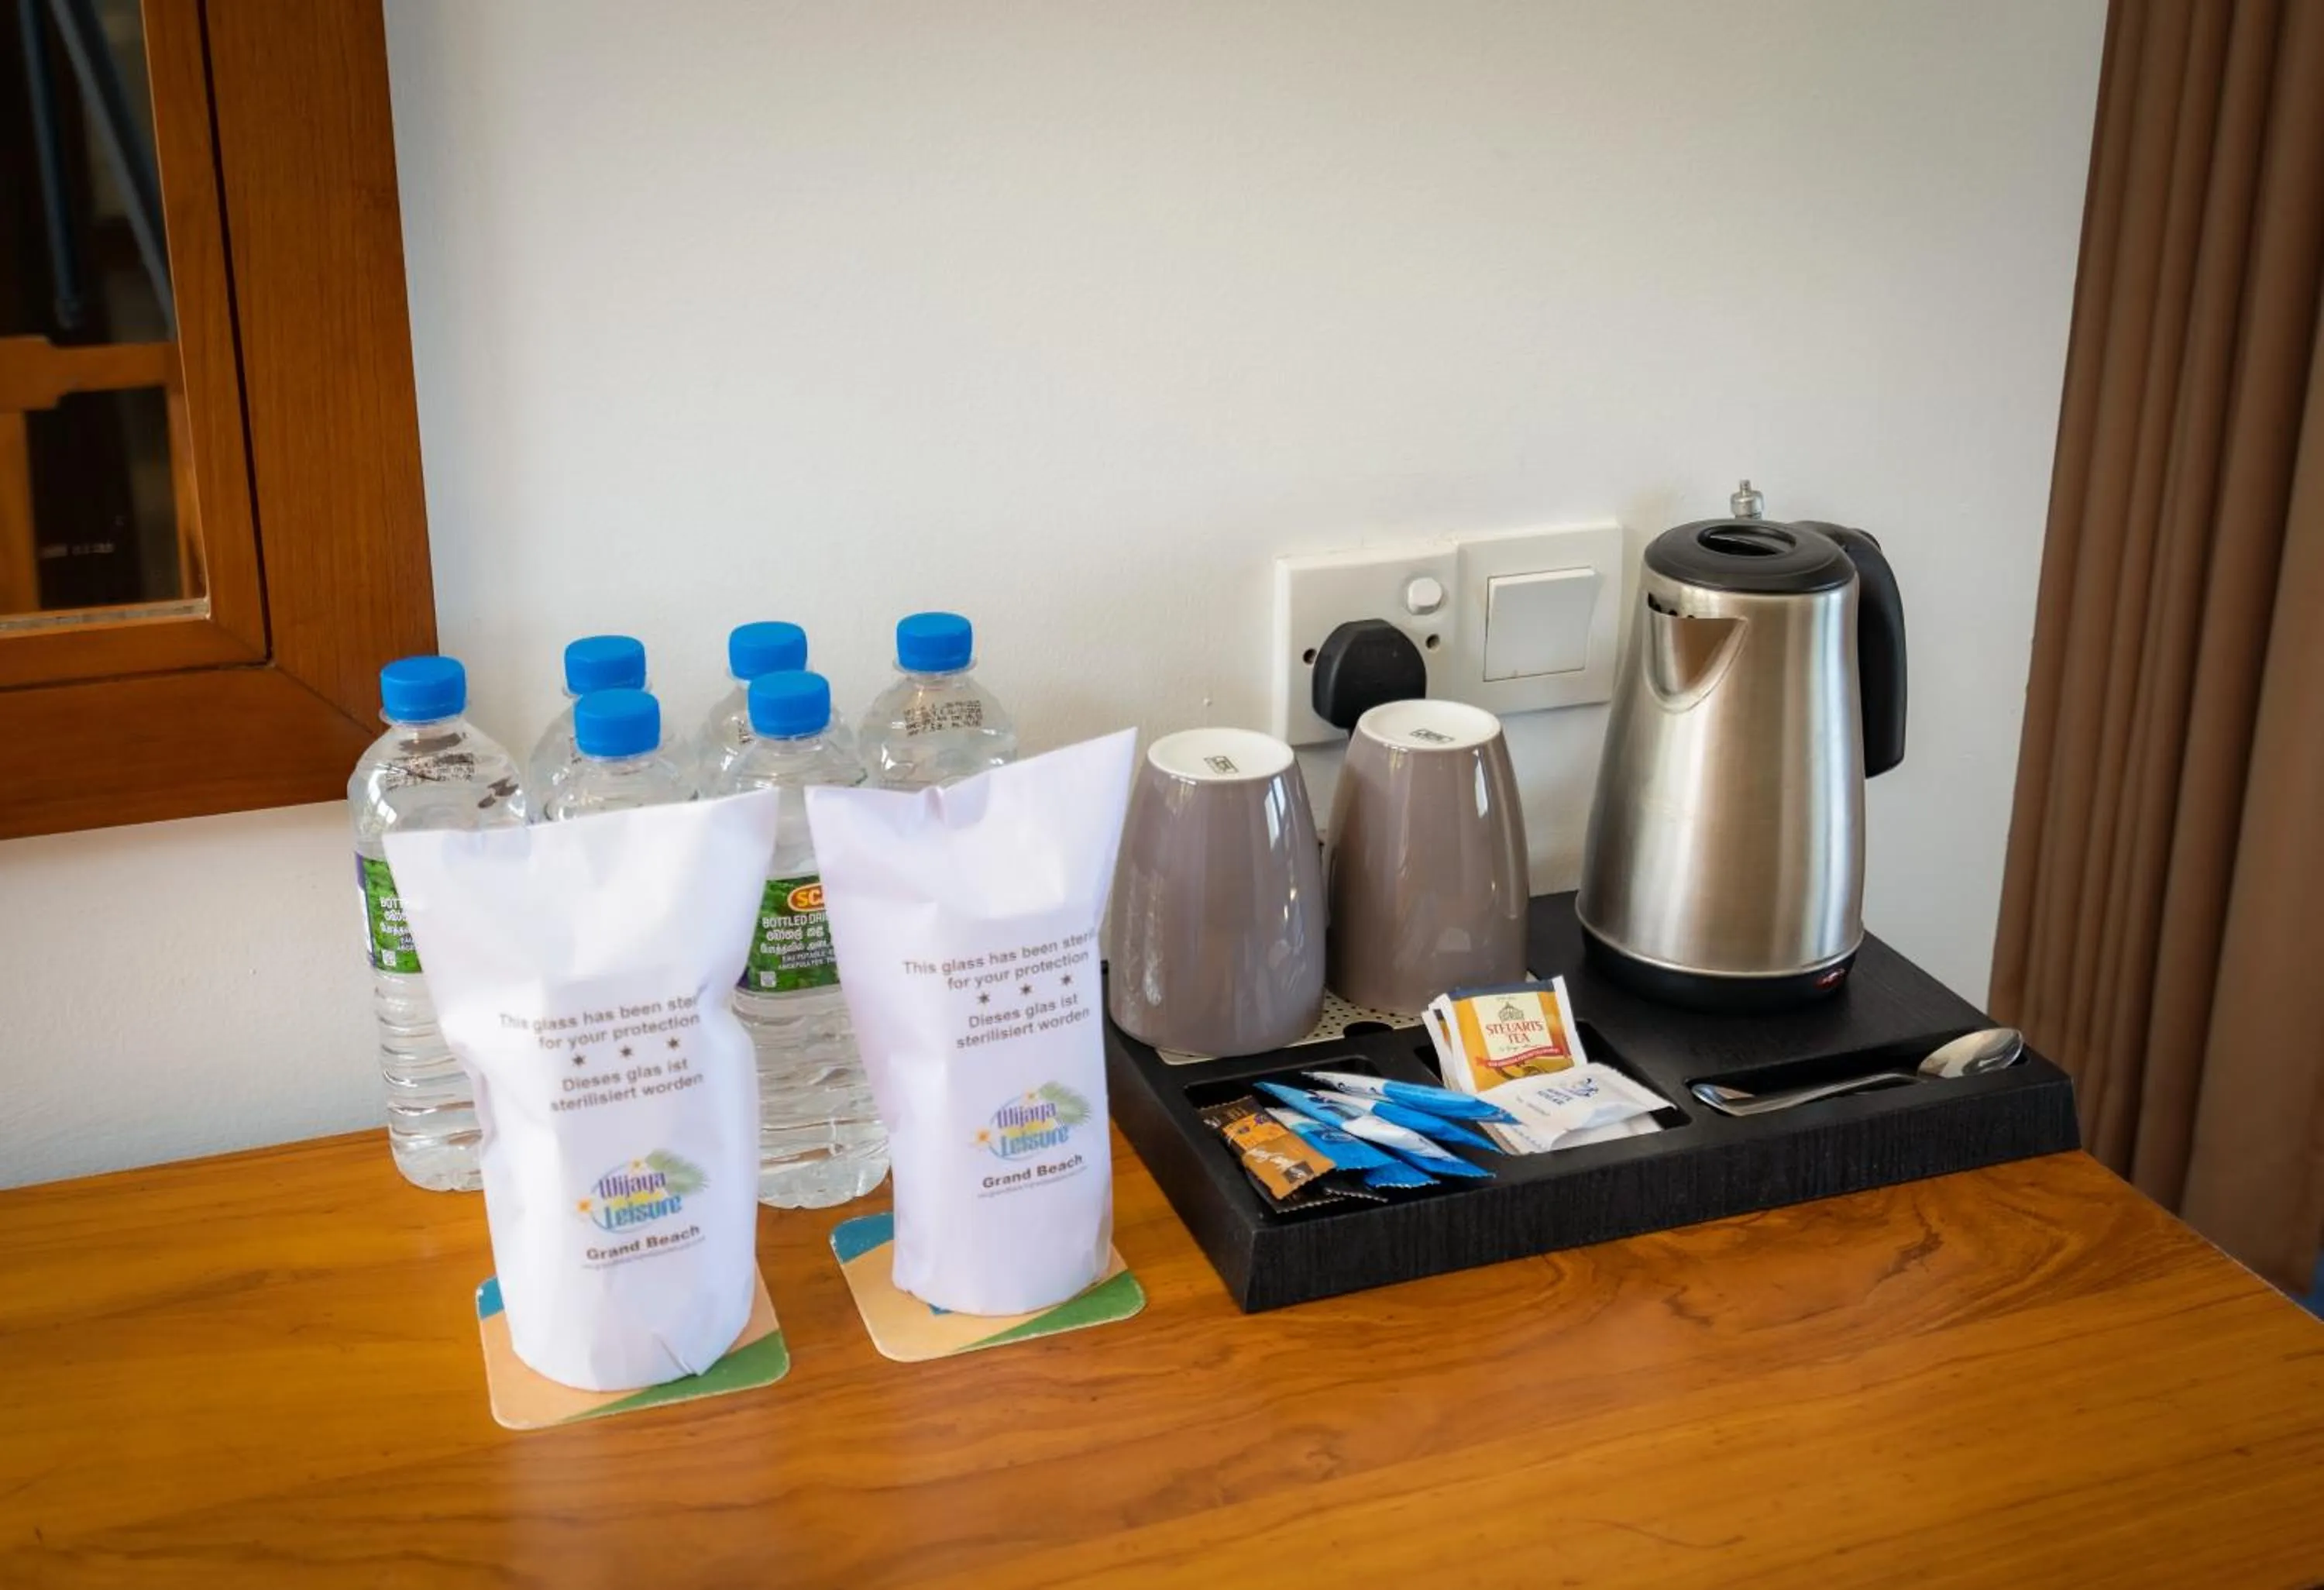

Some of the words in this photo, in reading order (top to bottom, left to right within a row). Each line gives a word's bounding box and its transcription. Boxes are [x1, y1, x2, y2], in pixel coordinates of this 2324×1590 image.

[796, 889, 824, 907] SC
[762, 914, 807, 928] BOTTLED
[902, 961, 937, 975] This
[941, 957, 984, 976] glass
[989, 952, 1016, 965] has
[1022, 941, 1057, 959] been
[947, 976, 969, 991] for
[975, 972, 1009, 989] your
[1015, 951, 1089, 981] protection
[499, 1014, 528, 1031] This
[533, 1015, 577, 1034] glass
[583, 1011, 614, 1025] has
[620, 1001, 662, 1020] been
[956, 1024, 1033, 1049] sterilisiert
[1038, 1007, 1091, 1031] worden
[968, 1008, 1020, 1029] Dieses
[1025, 1000, 1057, 1019] glas
[1061, 993, 1078, 1007] ist
[1485, 1020, 1544, 1035] STEUARTS
[538, 1035, 562, 1049] for
[568, 1032, 607, 1051] your
[613, 1013, 700, 1042] protection
[1508, 1033, 1531, 1044] TEA
[551, 1086, 637, 1112] sterilisiert
[642, 1072, 703, 1096] worden
[562, 1072, 621, 1093] Dieses
[626, 1064, 662, 1084] glas
[667, 1058, 689, 1074] ist
[1000, 1125, 1069, 1158] Leisure
[982, 1168, 1031, 1189] Grand
[1037, 1153, 1084, 1178] Beach
[604, 1194, 682, 1230] Leisure
[586, 1241, 640, 1261] Grand
[646, 1225, 700, 1248] Beach
